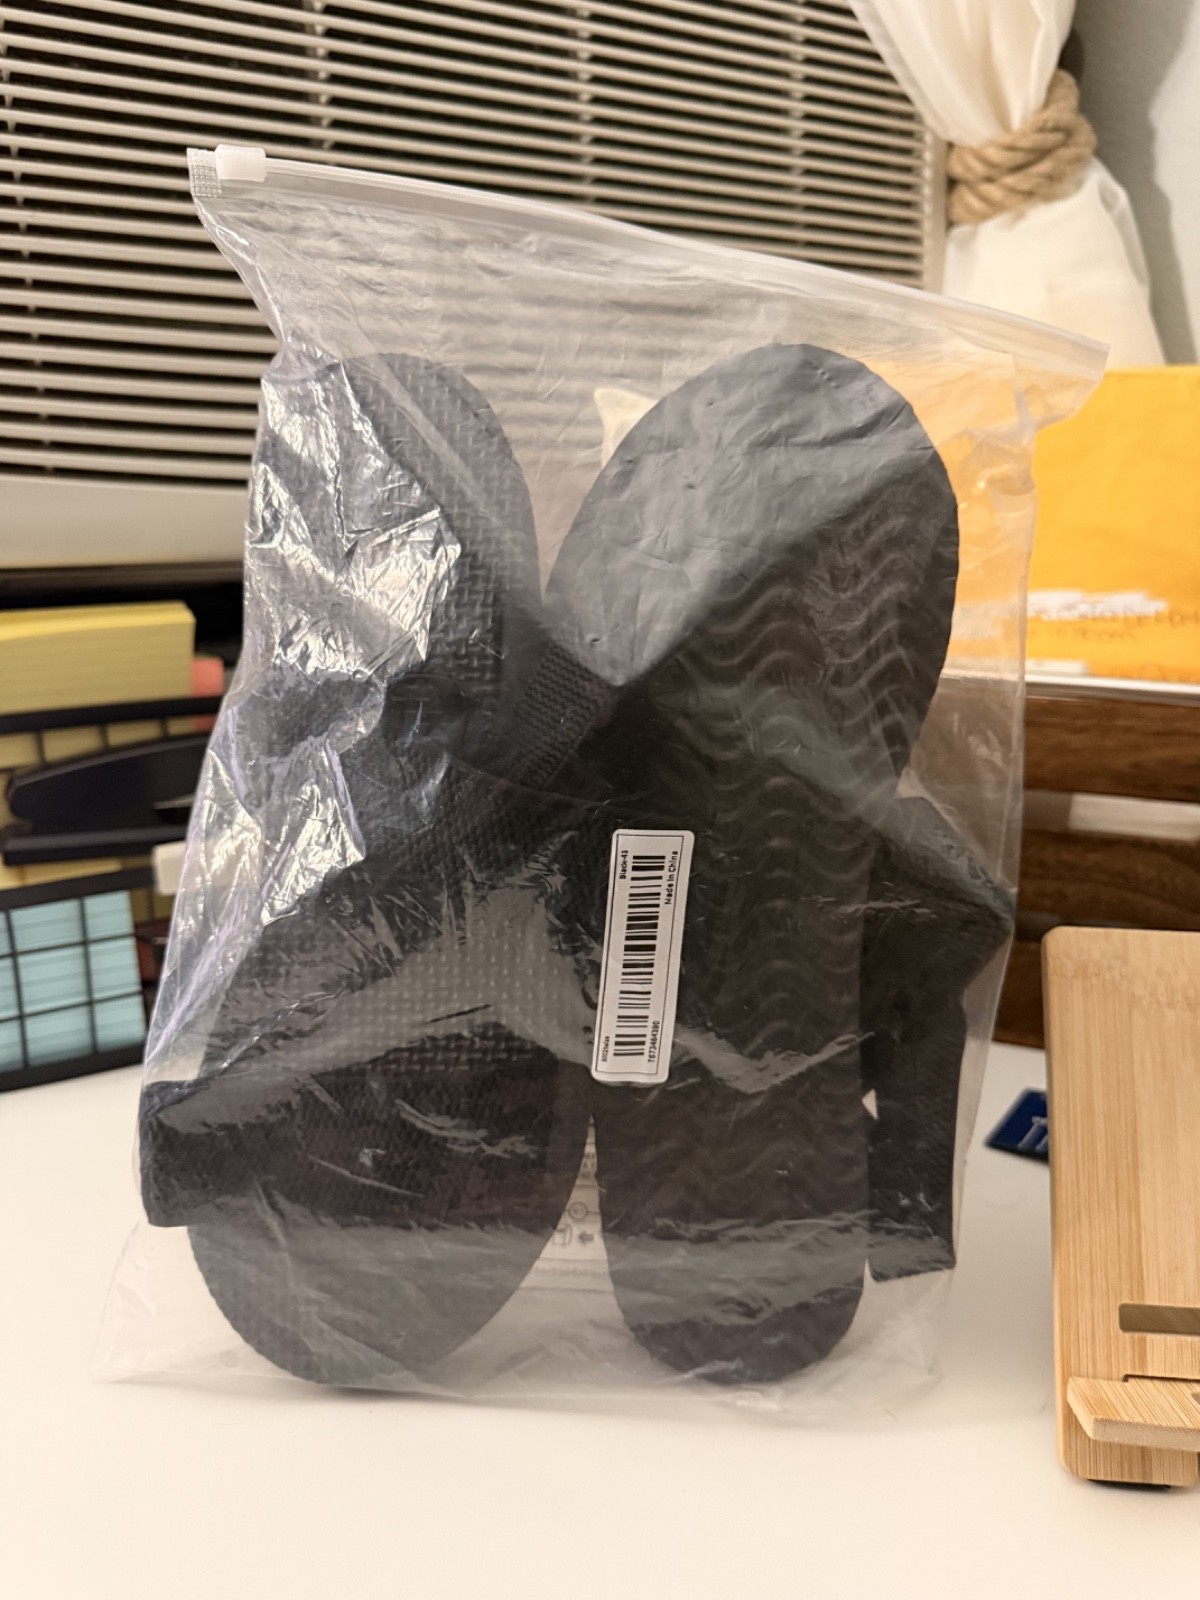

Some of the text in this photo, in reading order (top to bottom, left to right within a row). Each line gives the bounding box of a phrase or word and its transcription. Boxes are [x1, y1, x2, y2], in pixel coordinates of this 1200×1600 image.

[619, 850, 629, 879] Black-43
[668, 851, 679, 873] China
[664, 883, 674, 905] Made
